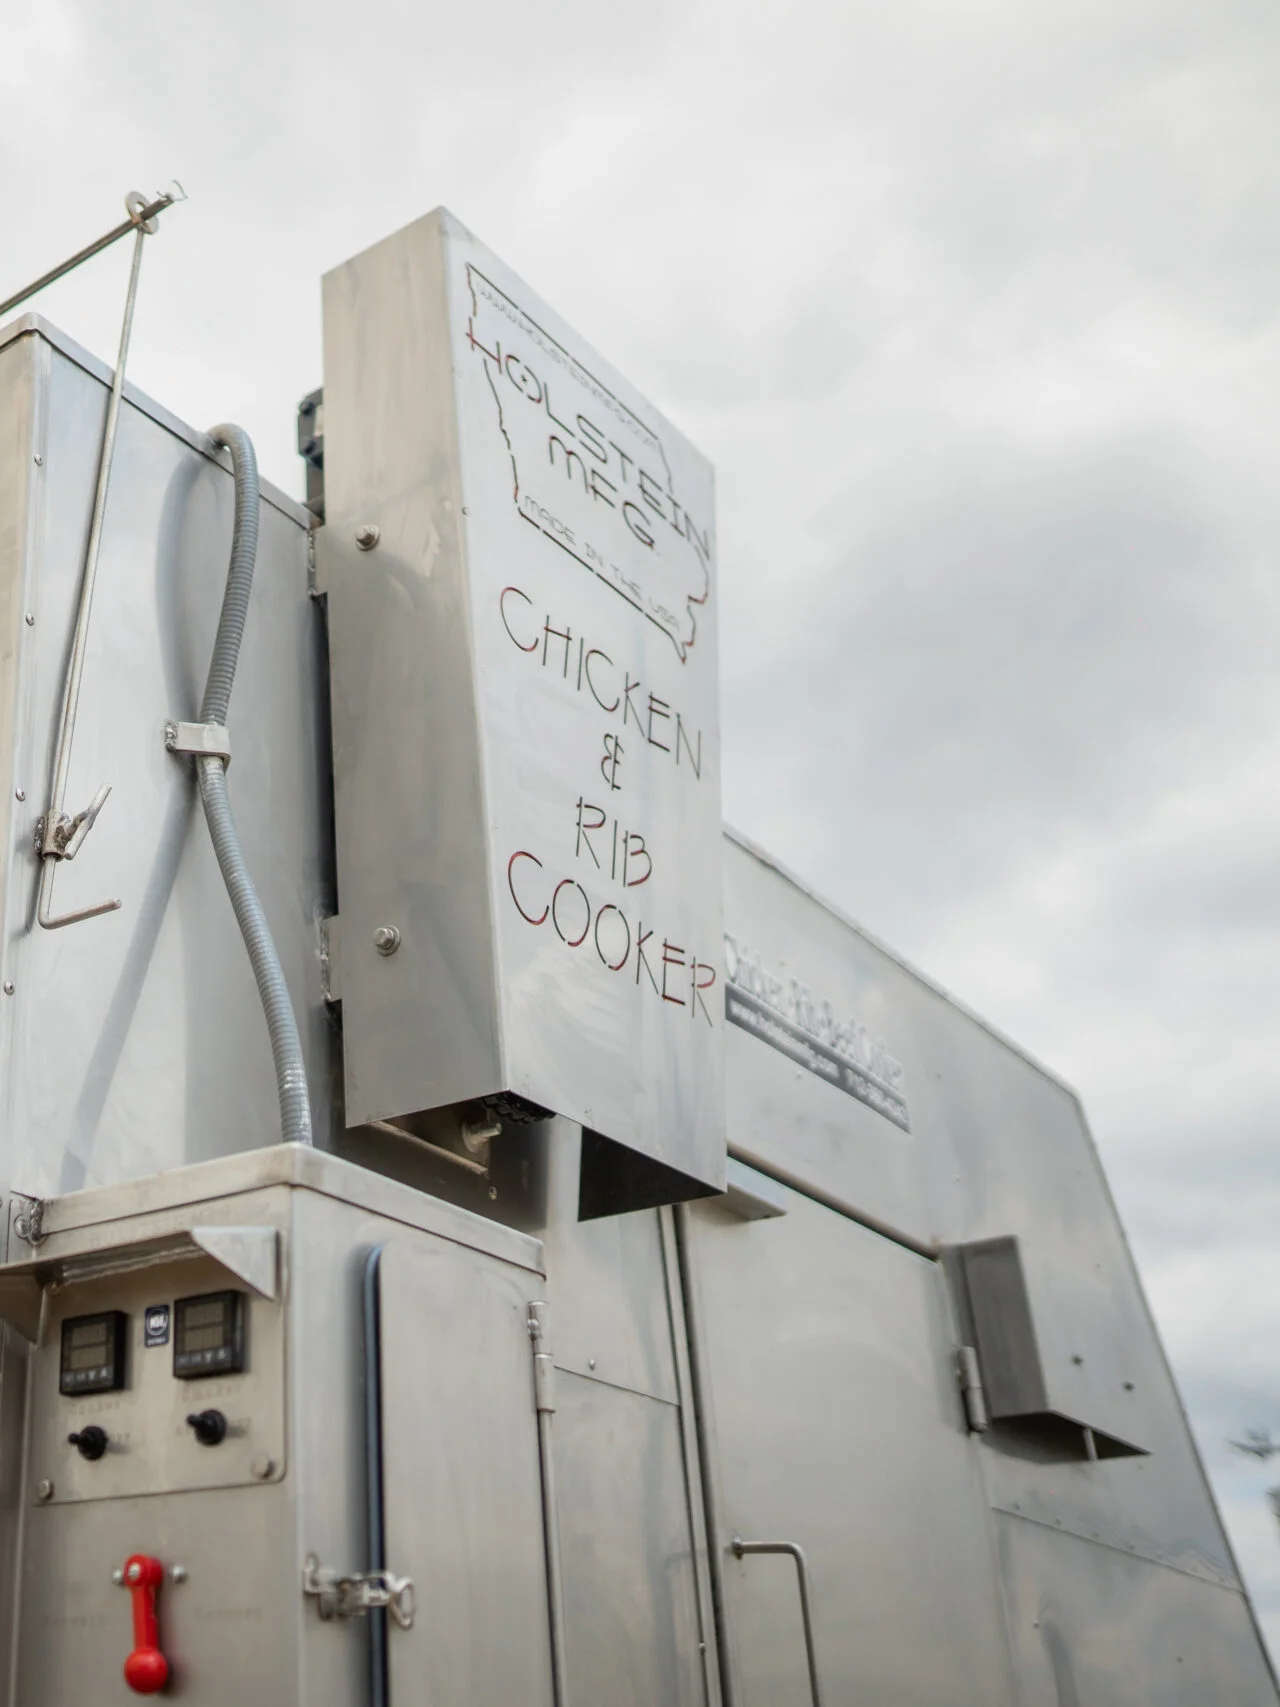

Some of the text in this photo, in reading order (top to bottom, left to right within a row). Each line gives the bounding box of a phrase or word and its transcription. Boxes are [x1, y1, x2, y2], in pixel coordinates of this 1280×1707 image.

[466, 317, 710, 560] HOLSTEIN
[525, 495, 680, 632] MADE IN THE USA
[500, 587, 700, 780] CHICKEN
[601, 734, 624, 790] &
[576, 796, 653, 887] RIB
[508, 851, 716, 1027] COOKER
